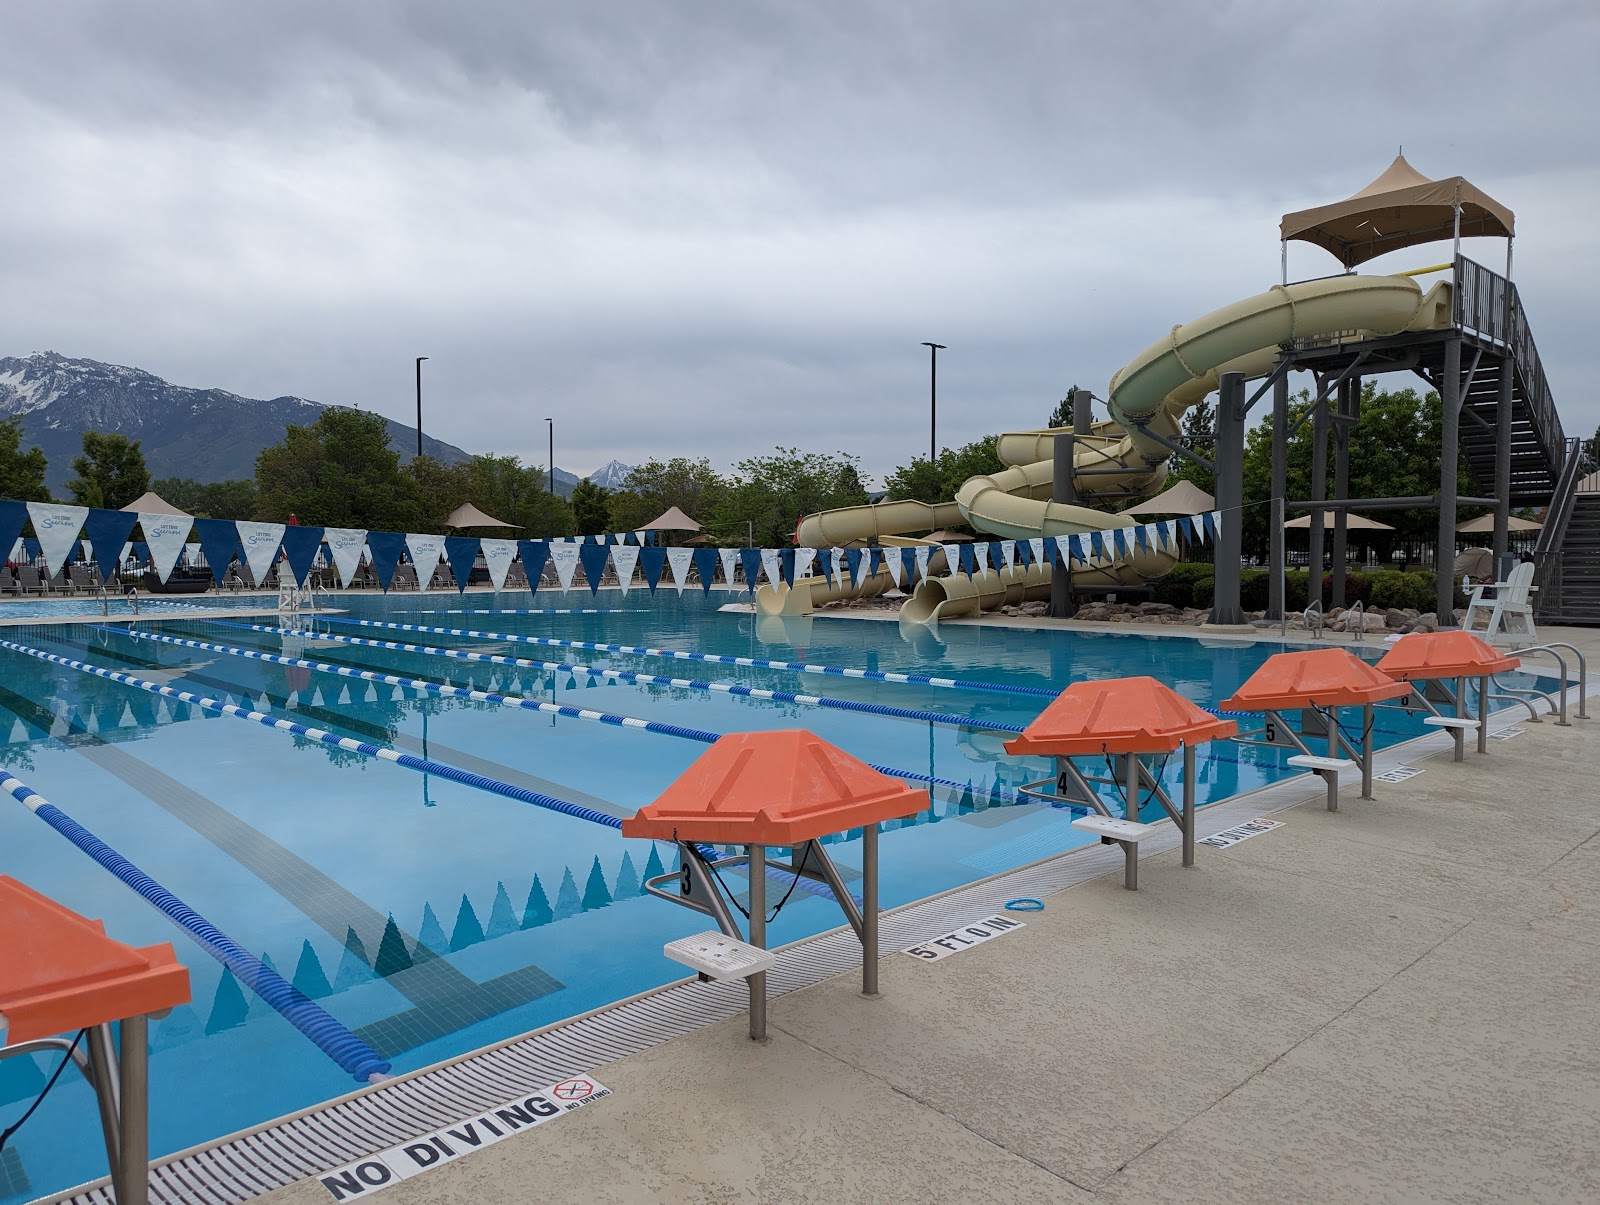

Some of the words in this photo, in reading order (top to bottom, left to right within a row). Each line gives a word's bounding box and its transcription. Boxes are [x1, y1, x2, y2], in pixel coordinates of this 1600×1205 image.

[41, 519, 75, 529] Swim
[150, 528, 181, 538] Swim
[247, 535, 275, 545] Swim
[1266, 723, 1275, 742] 5
[1057, 771, 1068, 795] 4
[681, 863, 692, 896] 3
[907, 946, 938, 959] 5
[565, 1102, 580, 1111] NO
[579, 1089, 611, 1105] DIVING
[320, 1161, 392, 1201] NO
[402, 1096, 560, 1168] DIVING
